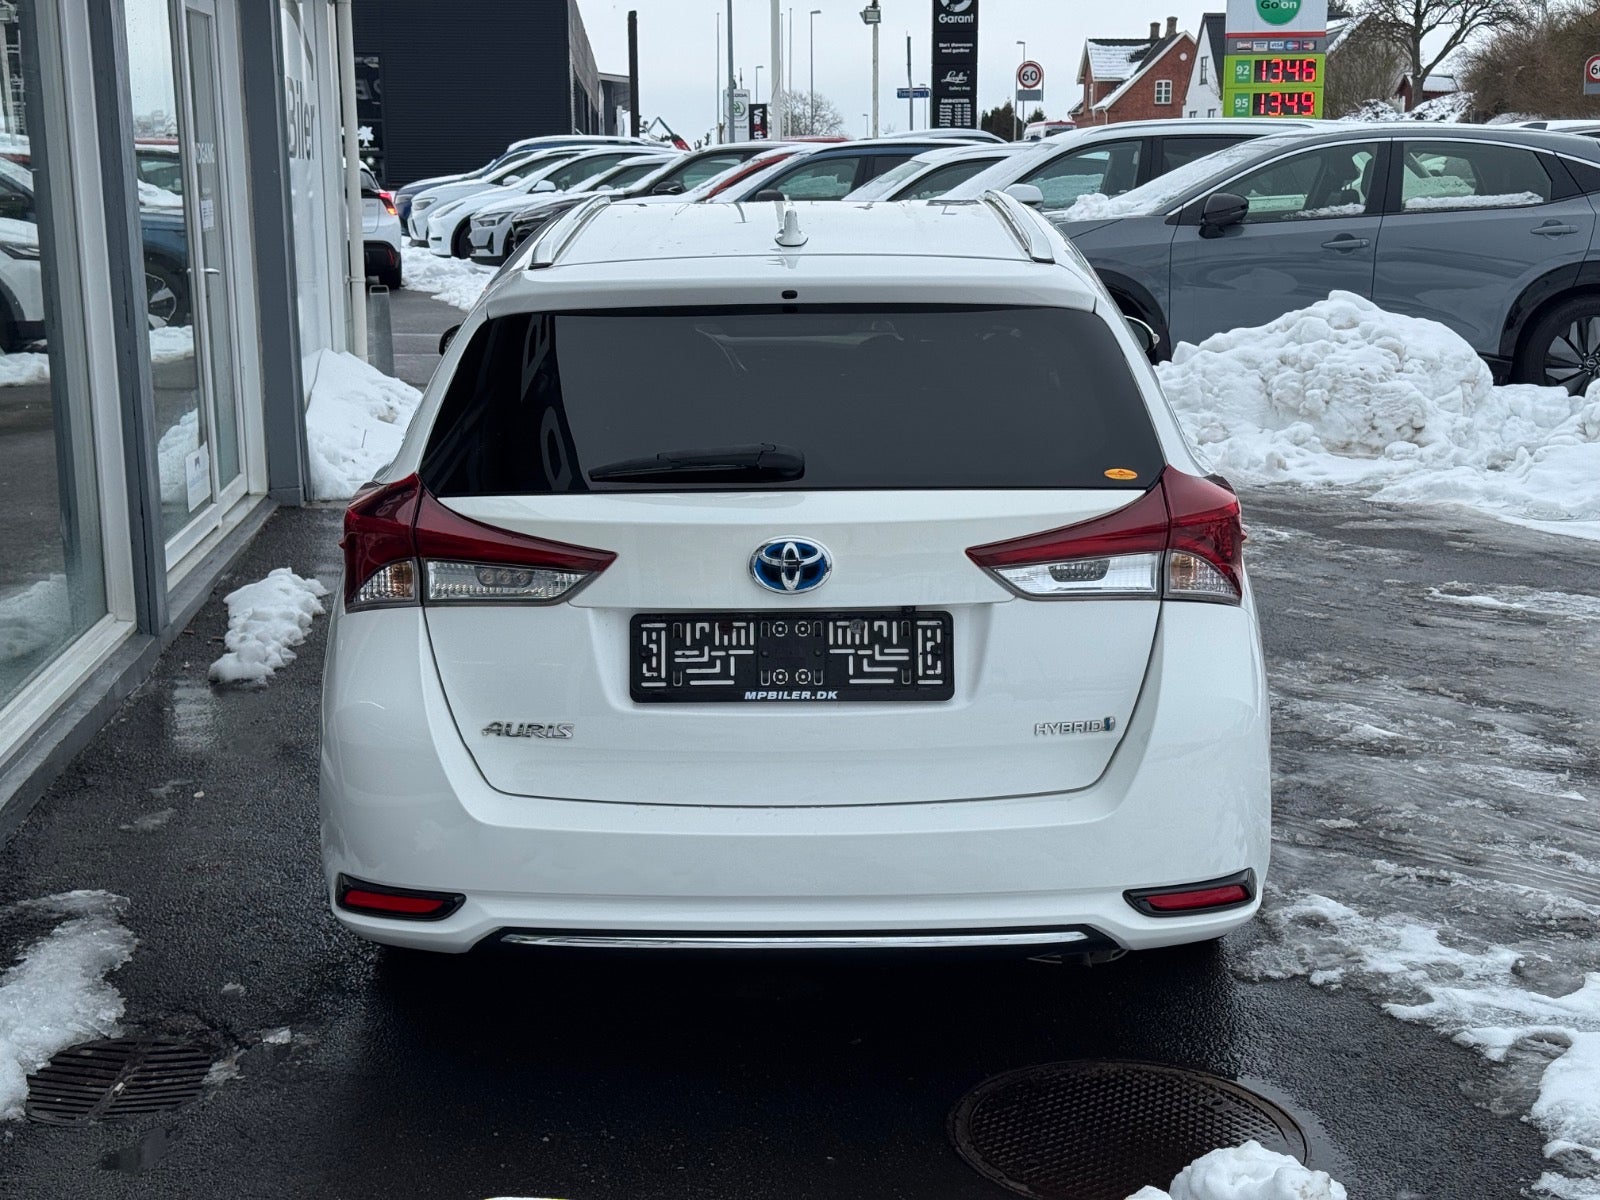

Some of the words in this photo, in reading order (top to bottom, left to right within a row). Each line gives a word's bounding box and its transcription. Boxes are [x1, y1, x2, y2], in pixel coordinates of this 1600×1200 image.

[938, 13, 974, 23] Garant
[1022, 70, 1038, 82] 60
[1236, 65, 1250, 75] 92
[1261, 58, 1317, 84] 13.46
[1591, 64, 1600, 75] 6
[1235, 98, 1249, 108] 95
[1260, 91, 1315, 116] 13.49
[286, 76, 315, 160] Biler
[744, 690, 839, 700] MPBILER.DK
[481, 721, 575, 739] AURIS
[1034, 719, 1103, 736] HYBRID
